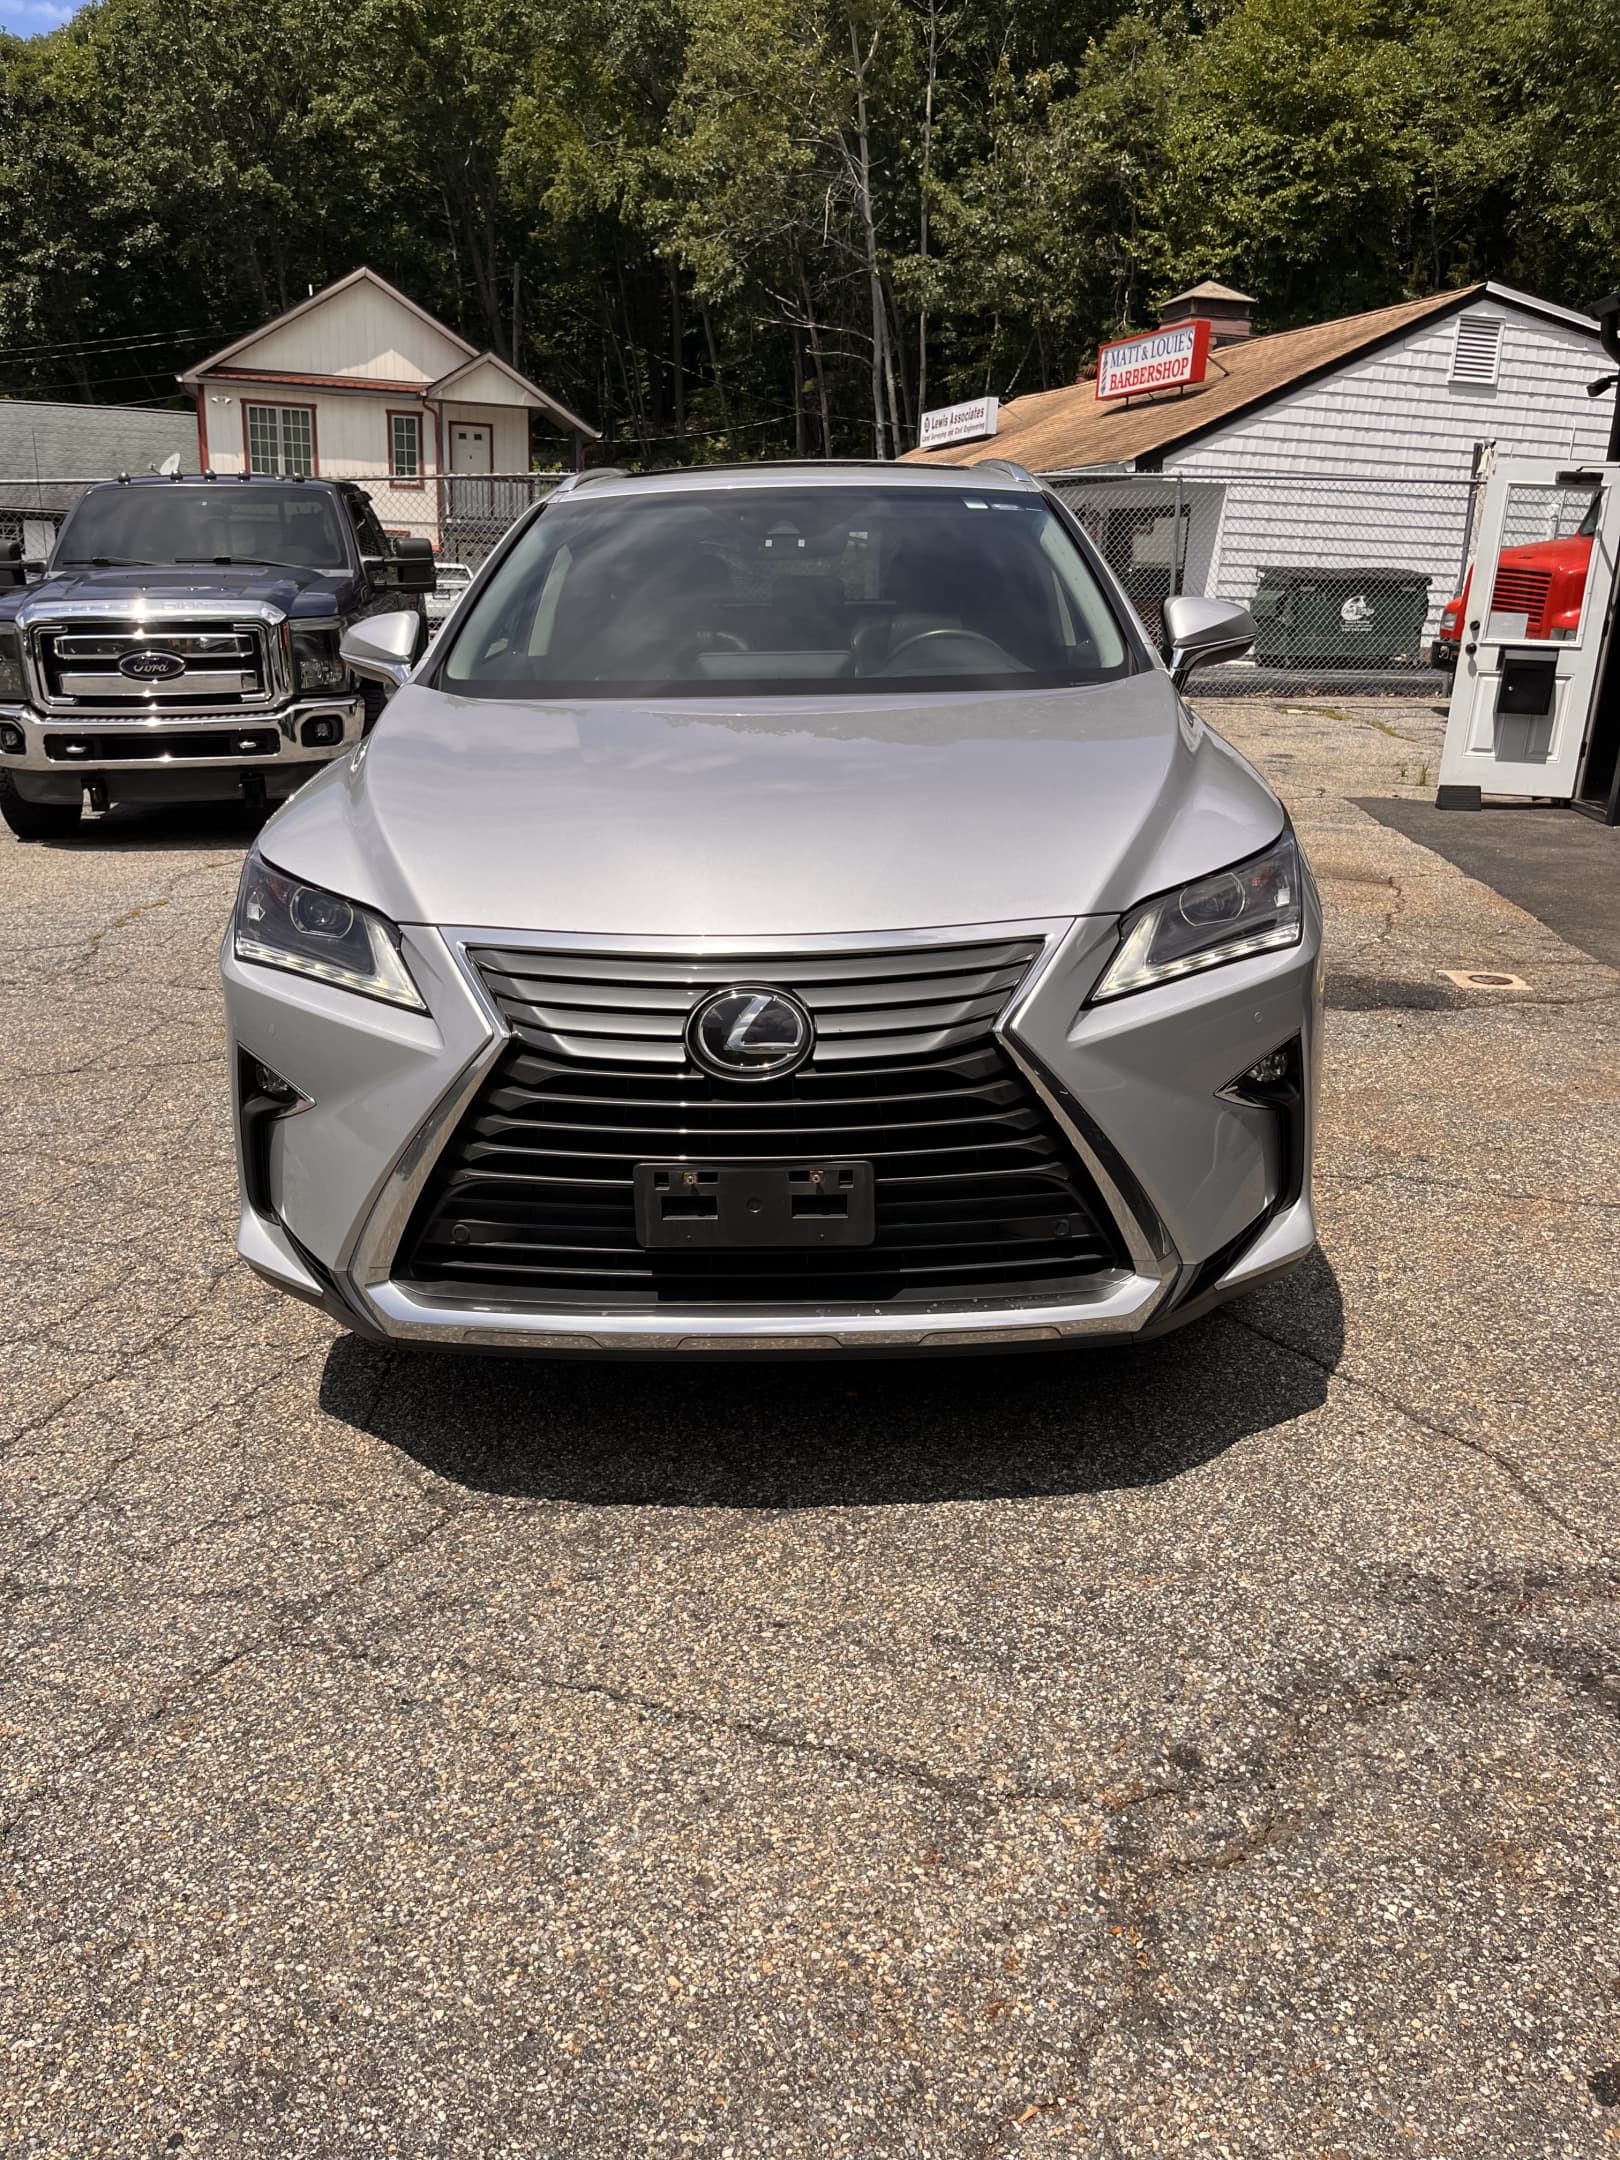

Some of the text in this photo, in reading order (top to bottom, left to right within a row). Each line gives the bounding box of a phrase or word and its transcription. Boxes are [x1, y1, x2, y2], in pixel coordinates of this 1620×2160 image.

[1110, 330, 1194, 369] MATT & LOUIE'S
[1109, 357, 1189, 391] BARBERSHOP
[931, 407, 984, 429] Lewis Associates
[132, 657, 169, 673] Ford
